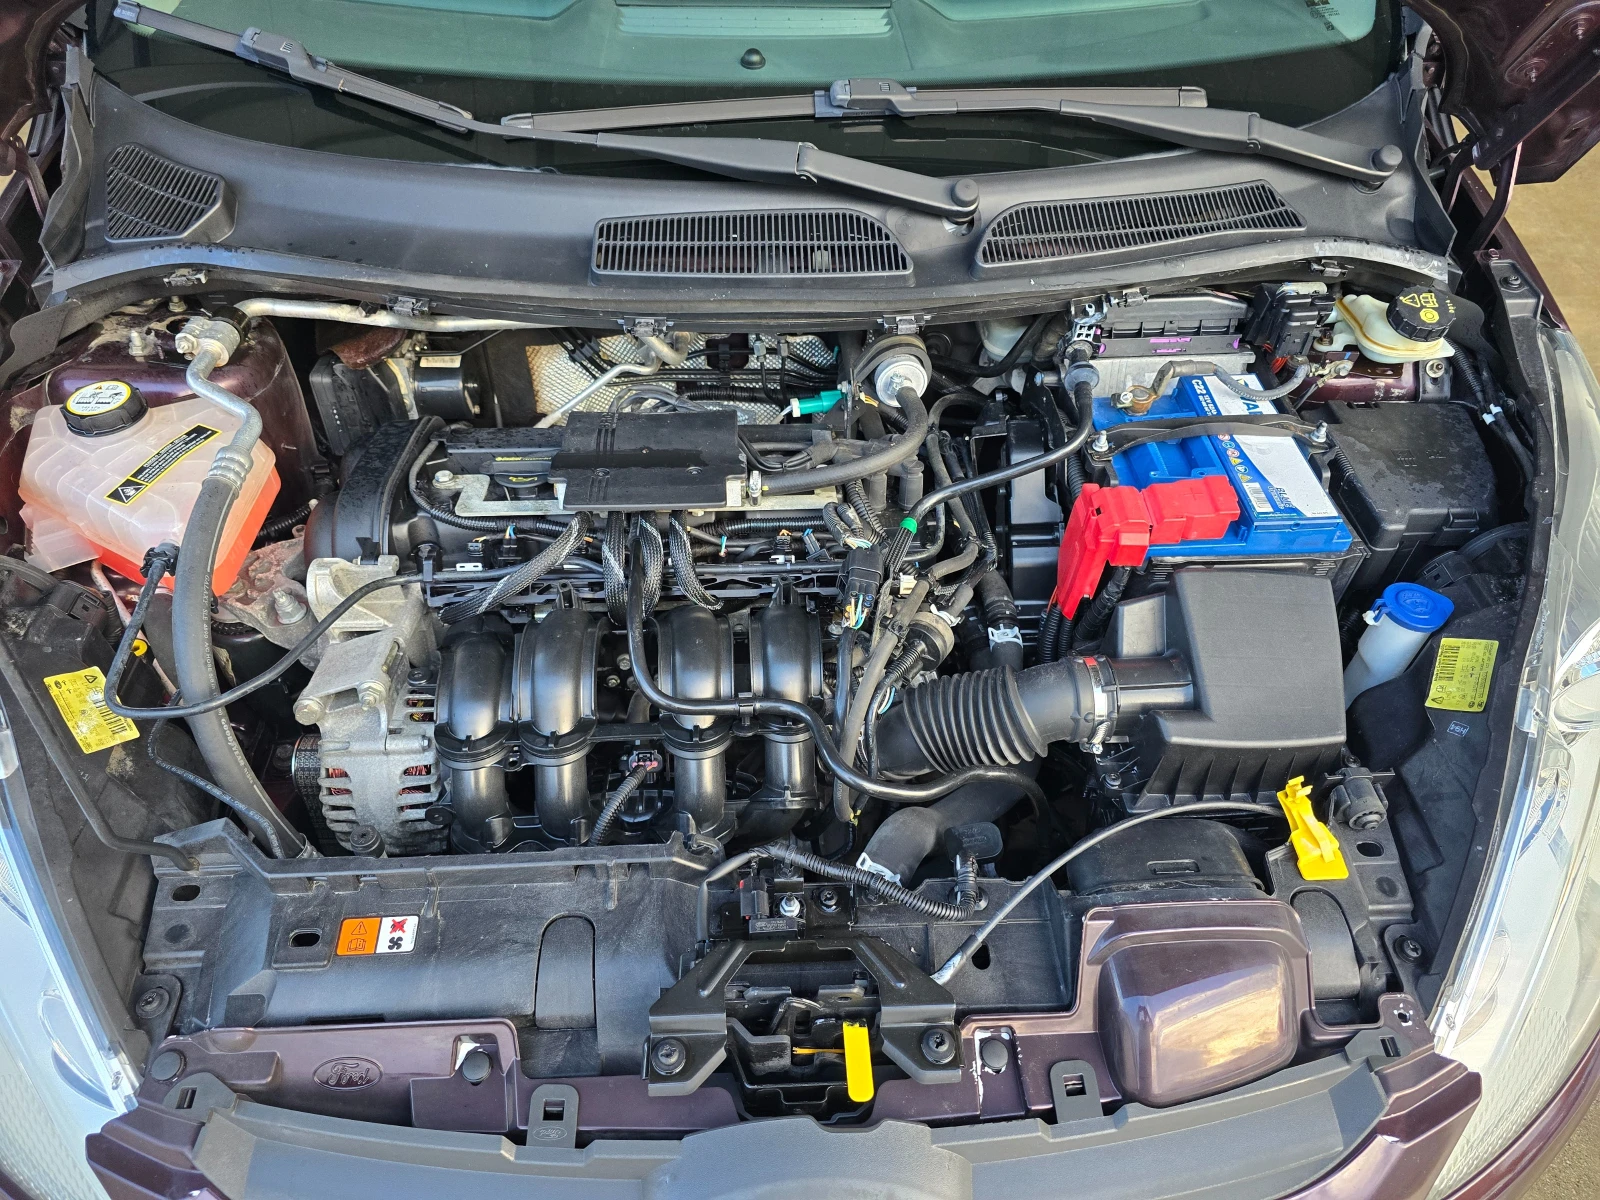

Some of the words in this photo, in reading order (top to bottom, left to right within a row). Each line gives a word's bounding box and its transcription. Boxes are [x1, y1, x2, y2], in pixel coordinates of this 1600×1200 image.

[1192, 379, 1207, 395] C22
[221, 718, 245, 767] GOODYEAR
[326, 1061, 371, 1086] Ford
[540, 1128, 561, 1139] Ford
